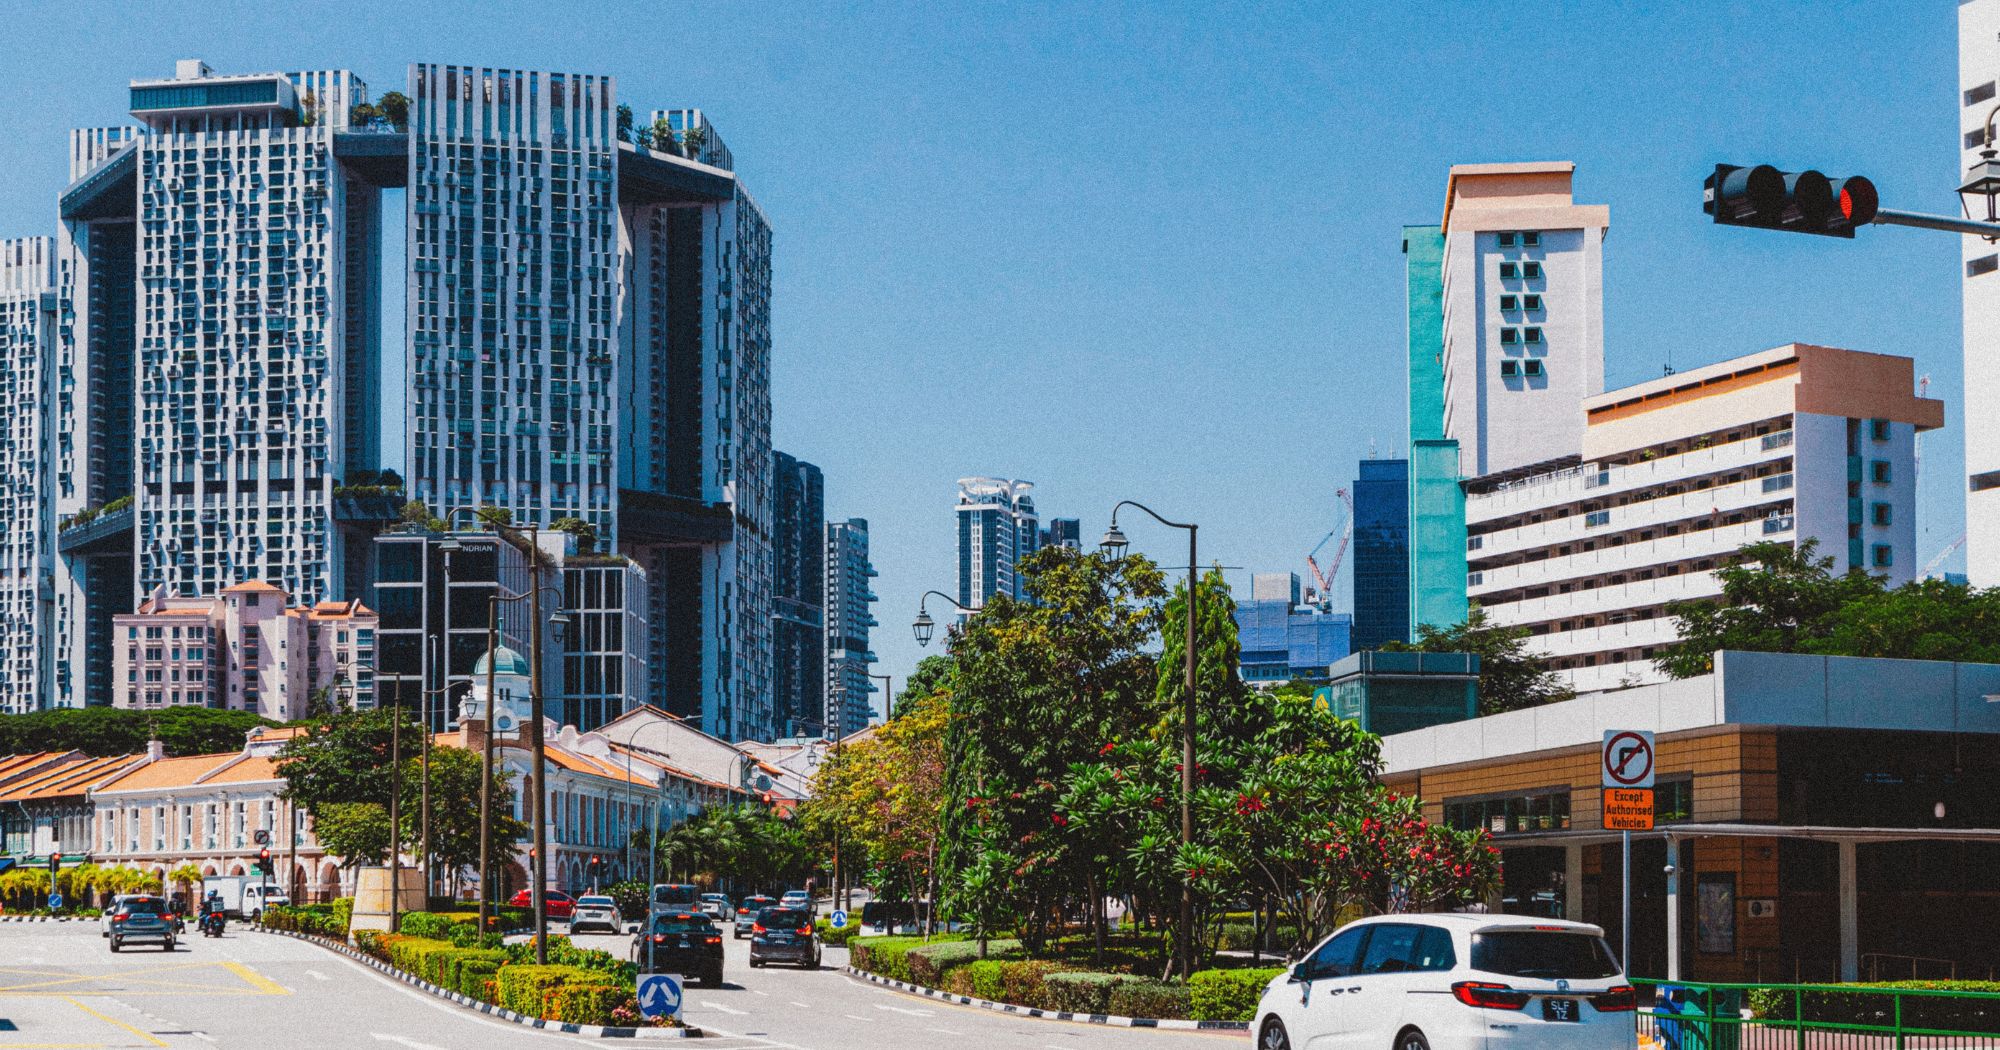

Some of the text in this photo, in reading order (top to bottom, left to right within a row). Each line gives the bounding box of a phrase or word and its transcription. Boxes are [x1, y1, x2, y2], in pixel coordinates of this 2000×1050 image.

[1614, 791, 1644, 806] Except
[1606, 804, 1653, 816] Authorised
[1611, 816, 1646, 828] Vehicles
[1551, 1001, 1570, 1010] SLF
